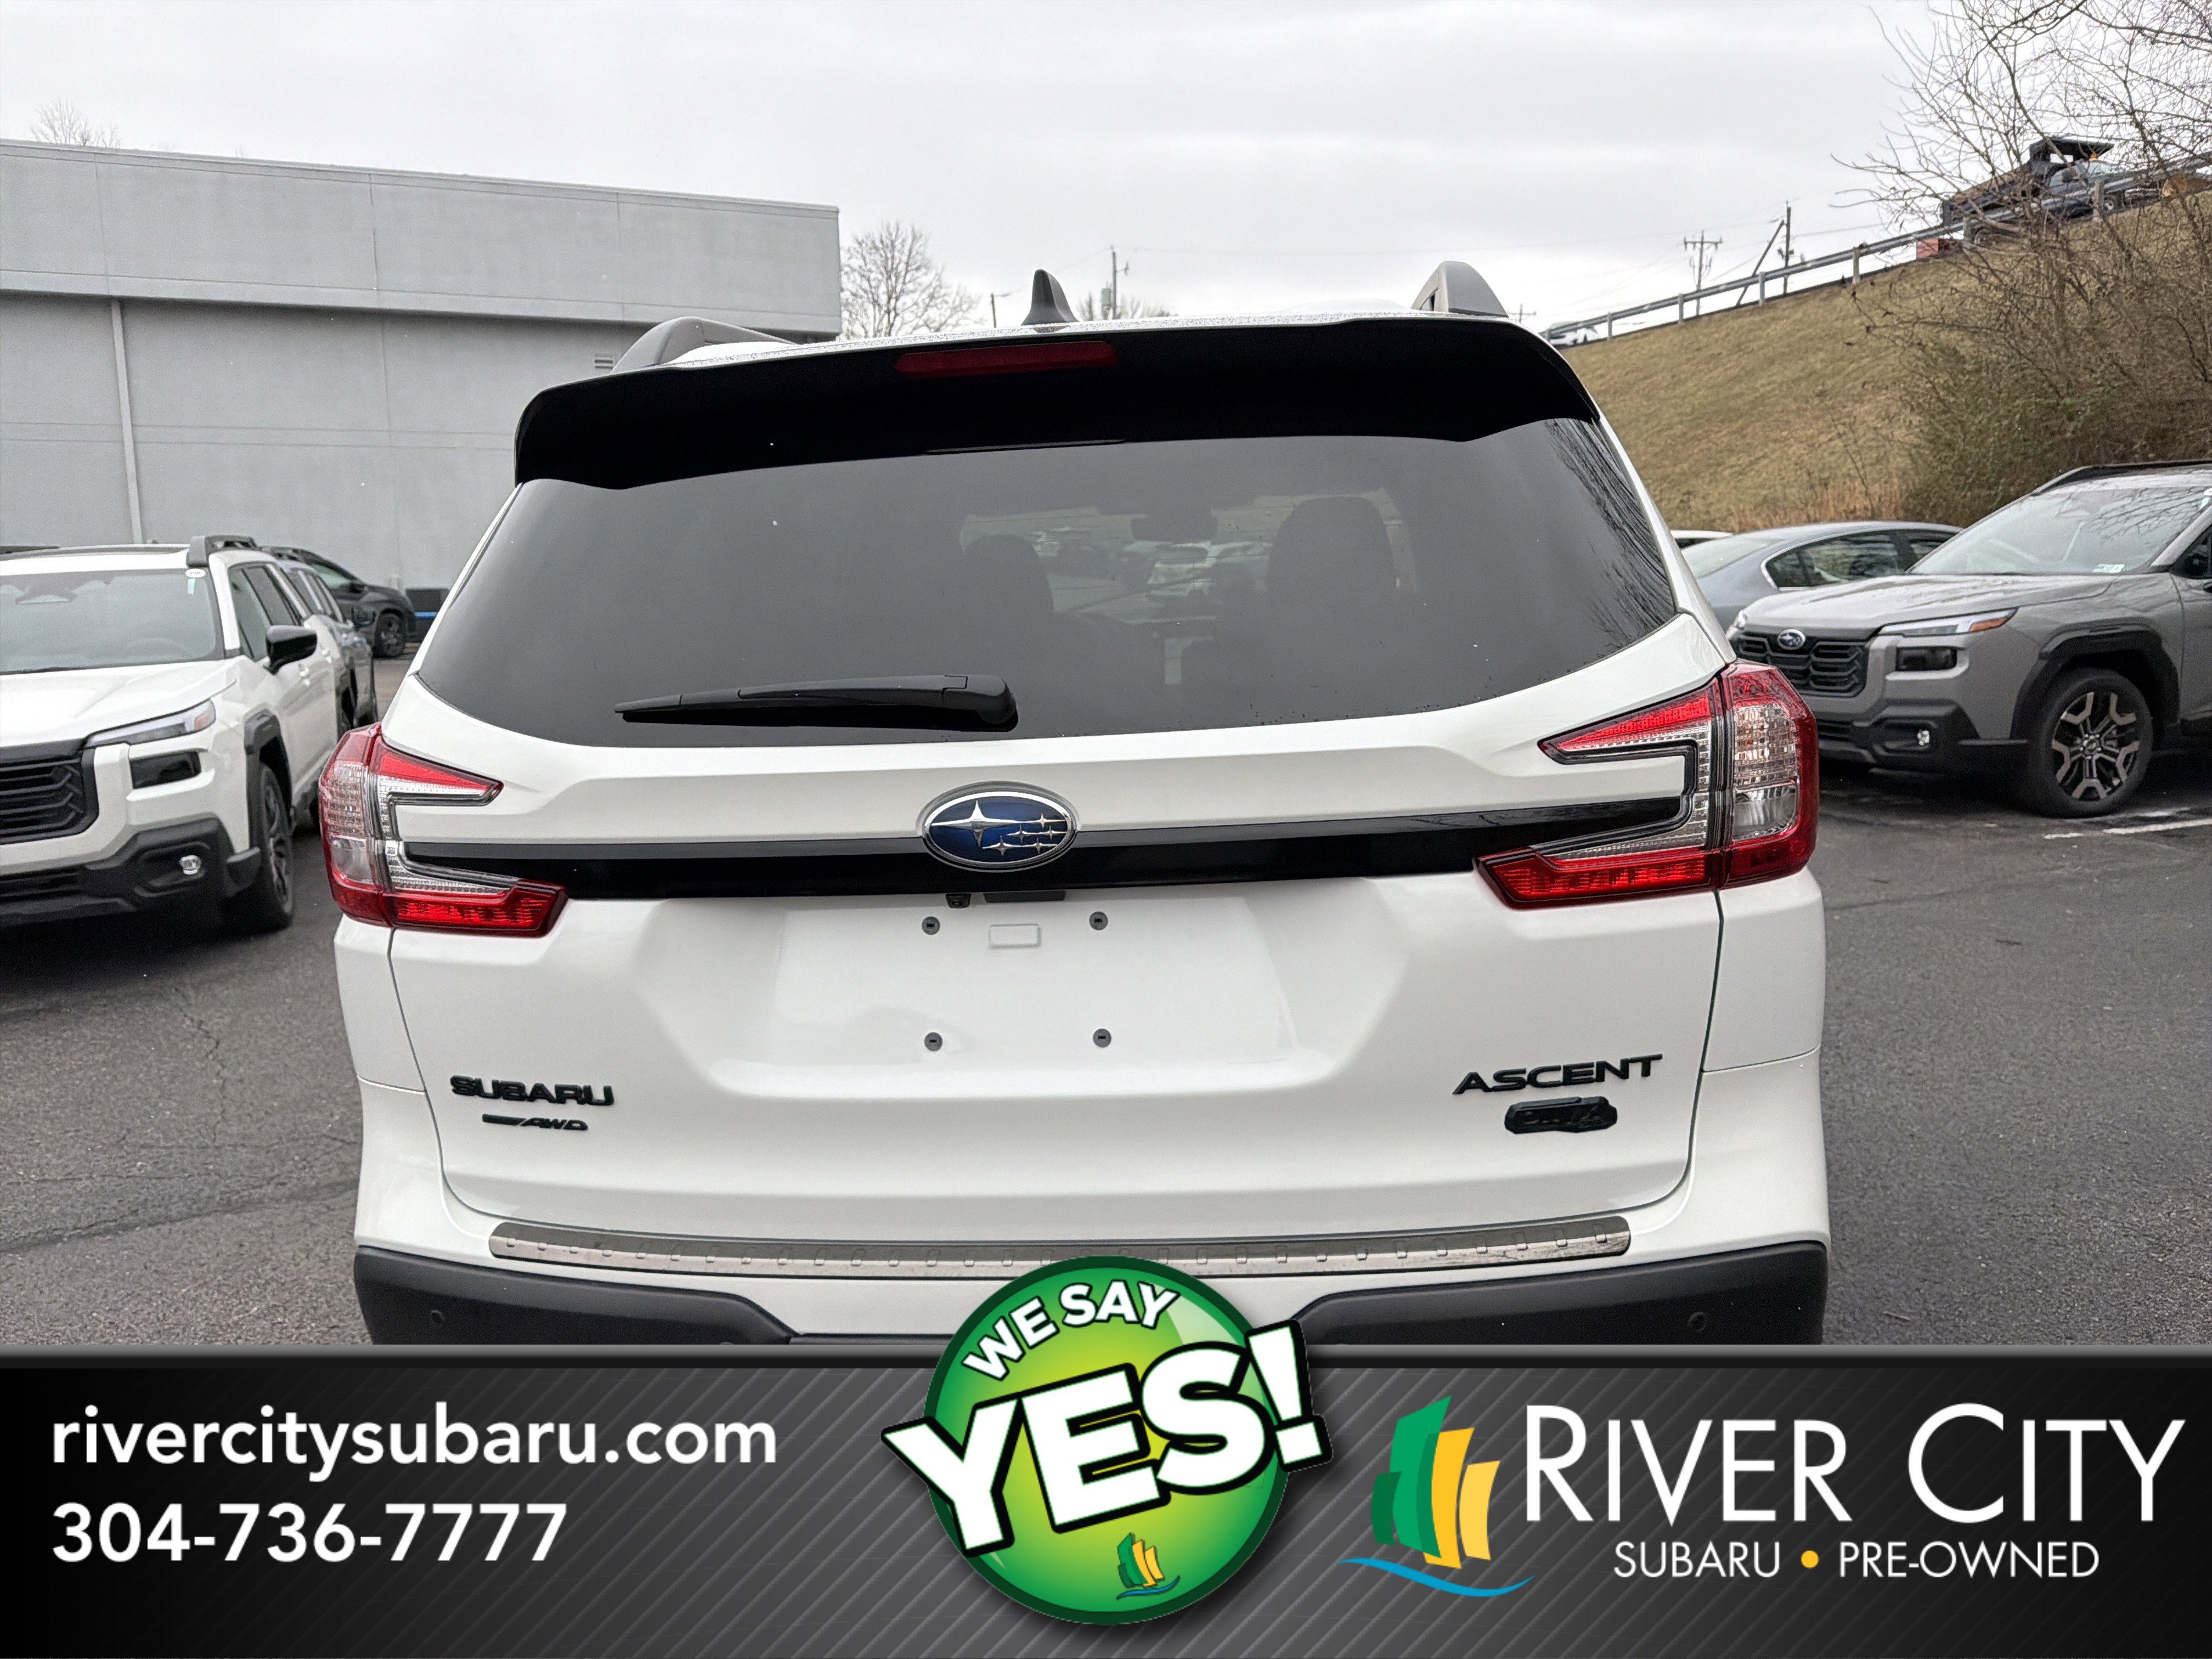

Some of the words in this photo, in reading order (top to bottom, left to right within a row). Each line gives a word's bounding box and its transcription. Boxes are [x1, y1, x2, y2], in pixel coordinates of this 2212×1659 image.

[1453, 1053, 1663, 1095] ASCENT
[450, 1075, 615, 1107] SUBARU
[520, 1117, 589, 1131] AWD
